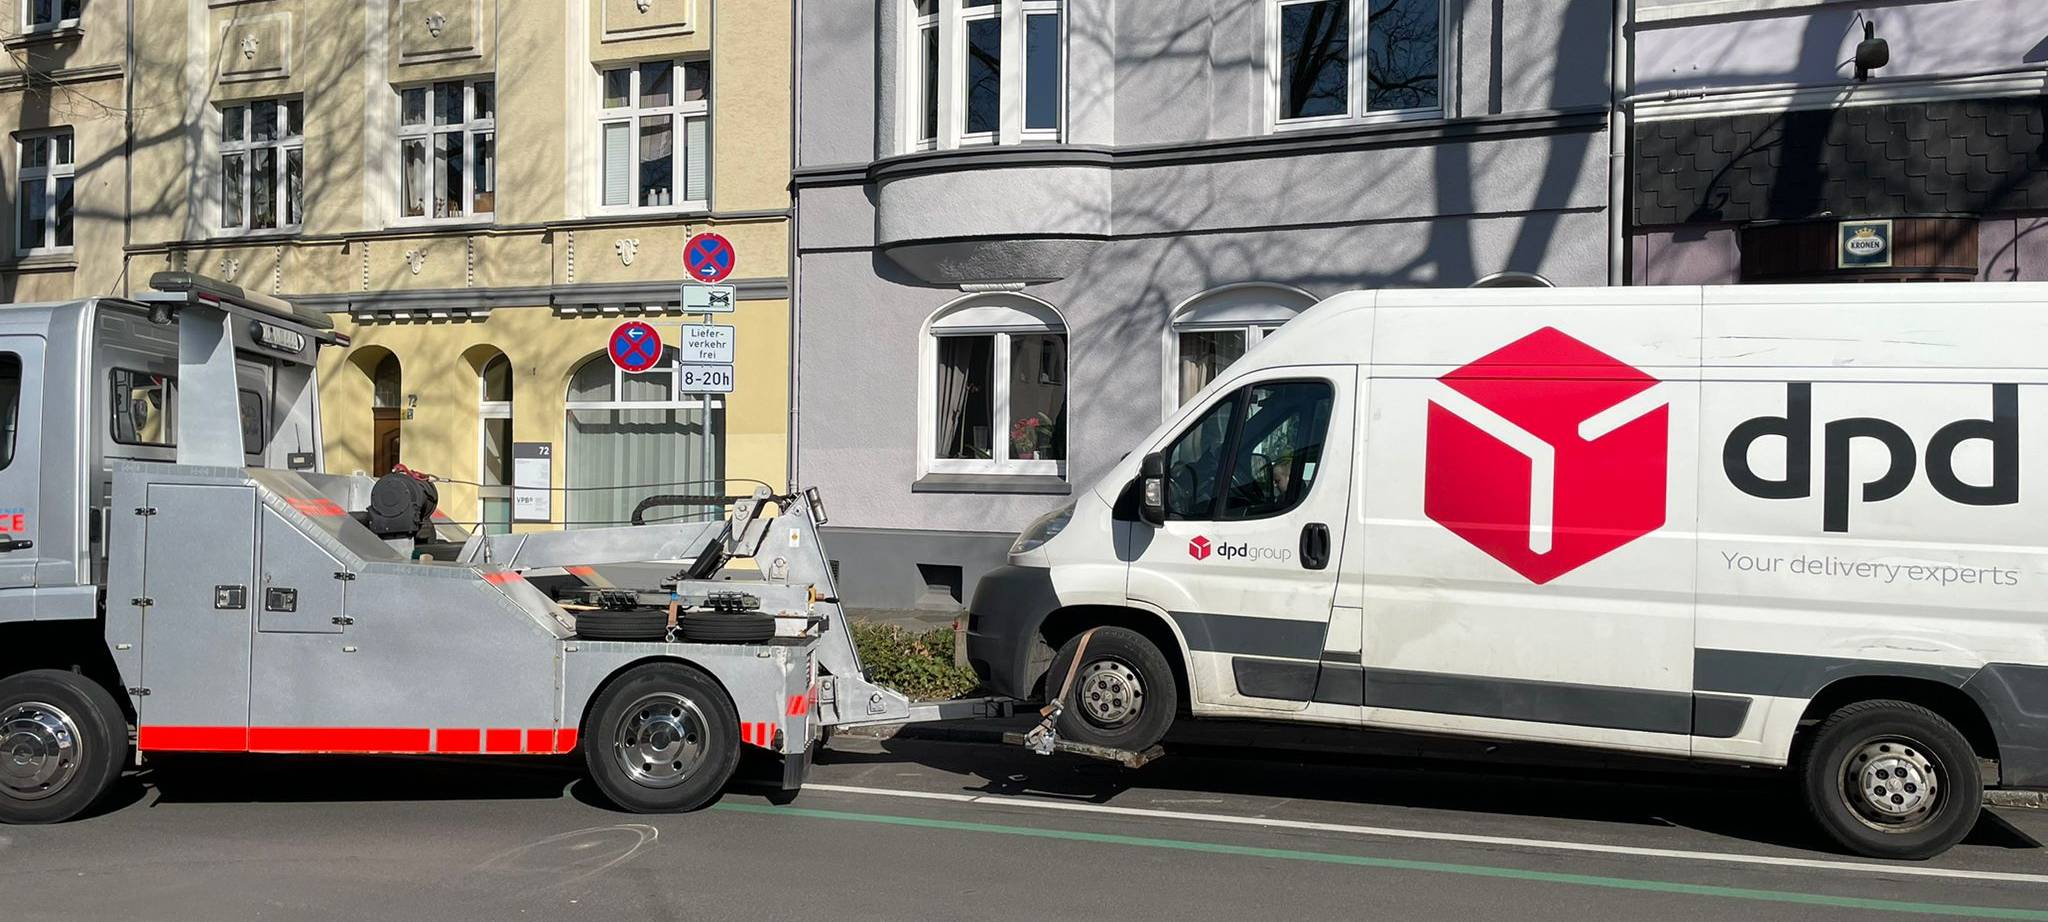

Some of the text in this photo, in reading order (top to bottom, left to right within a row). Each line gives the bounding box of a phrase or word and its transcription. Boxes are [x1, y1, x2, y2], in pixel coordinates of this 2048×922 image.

[1851, 241, 1880, 249] KRONEN
[691, 328, 725, 338] Liefer-
[688, 340, 726, 349] verkehr
[699, 350, 716, 359] frei
[685, 371, 729, 386] 8-20h
[538, 446, 550, 455] 72
[1722, 382, 2019, 533] dpd
[1217, 541, 1292, 562] dpdgroup
[1721, 550, 2019, 587] Your delivery experts
